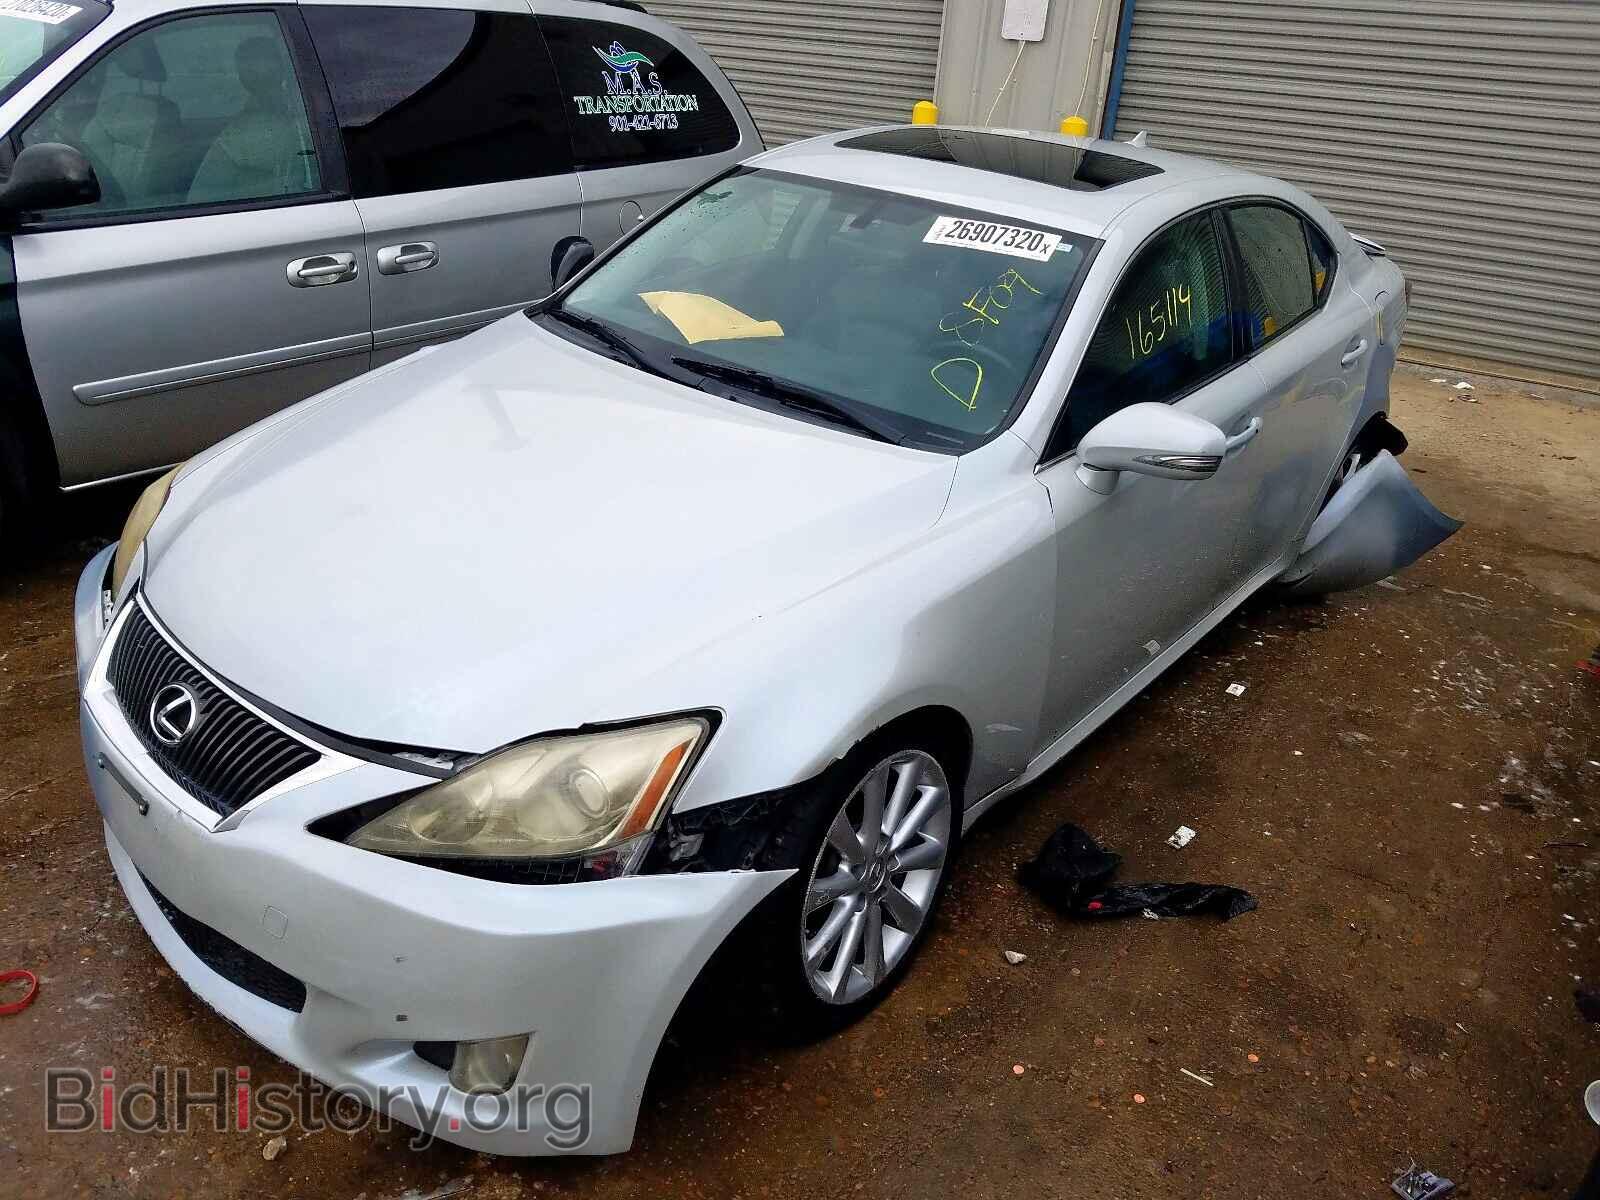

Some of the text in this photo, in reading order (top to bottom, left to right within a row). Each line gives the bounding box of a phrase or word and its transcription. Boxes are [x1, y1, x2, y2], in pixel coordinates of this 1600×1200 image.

[573, 95, 699, 114] TRANSPORTATION
[944, 220, 1045, 251] 26907320
[1126, 284, 1192, 360] 165114
